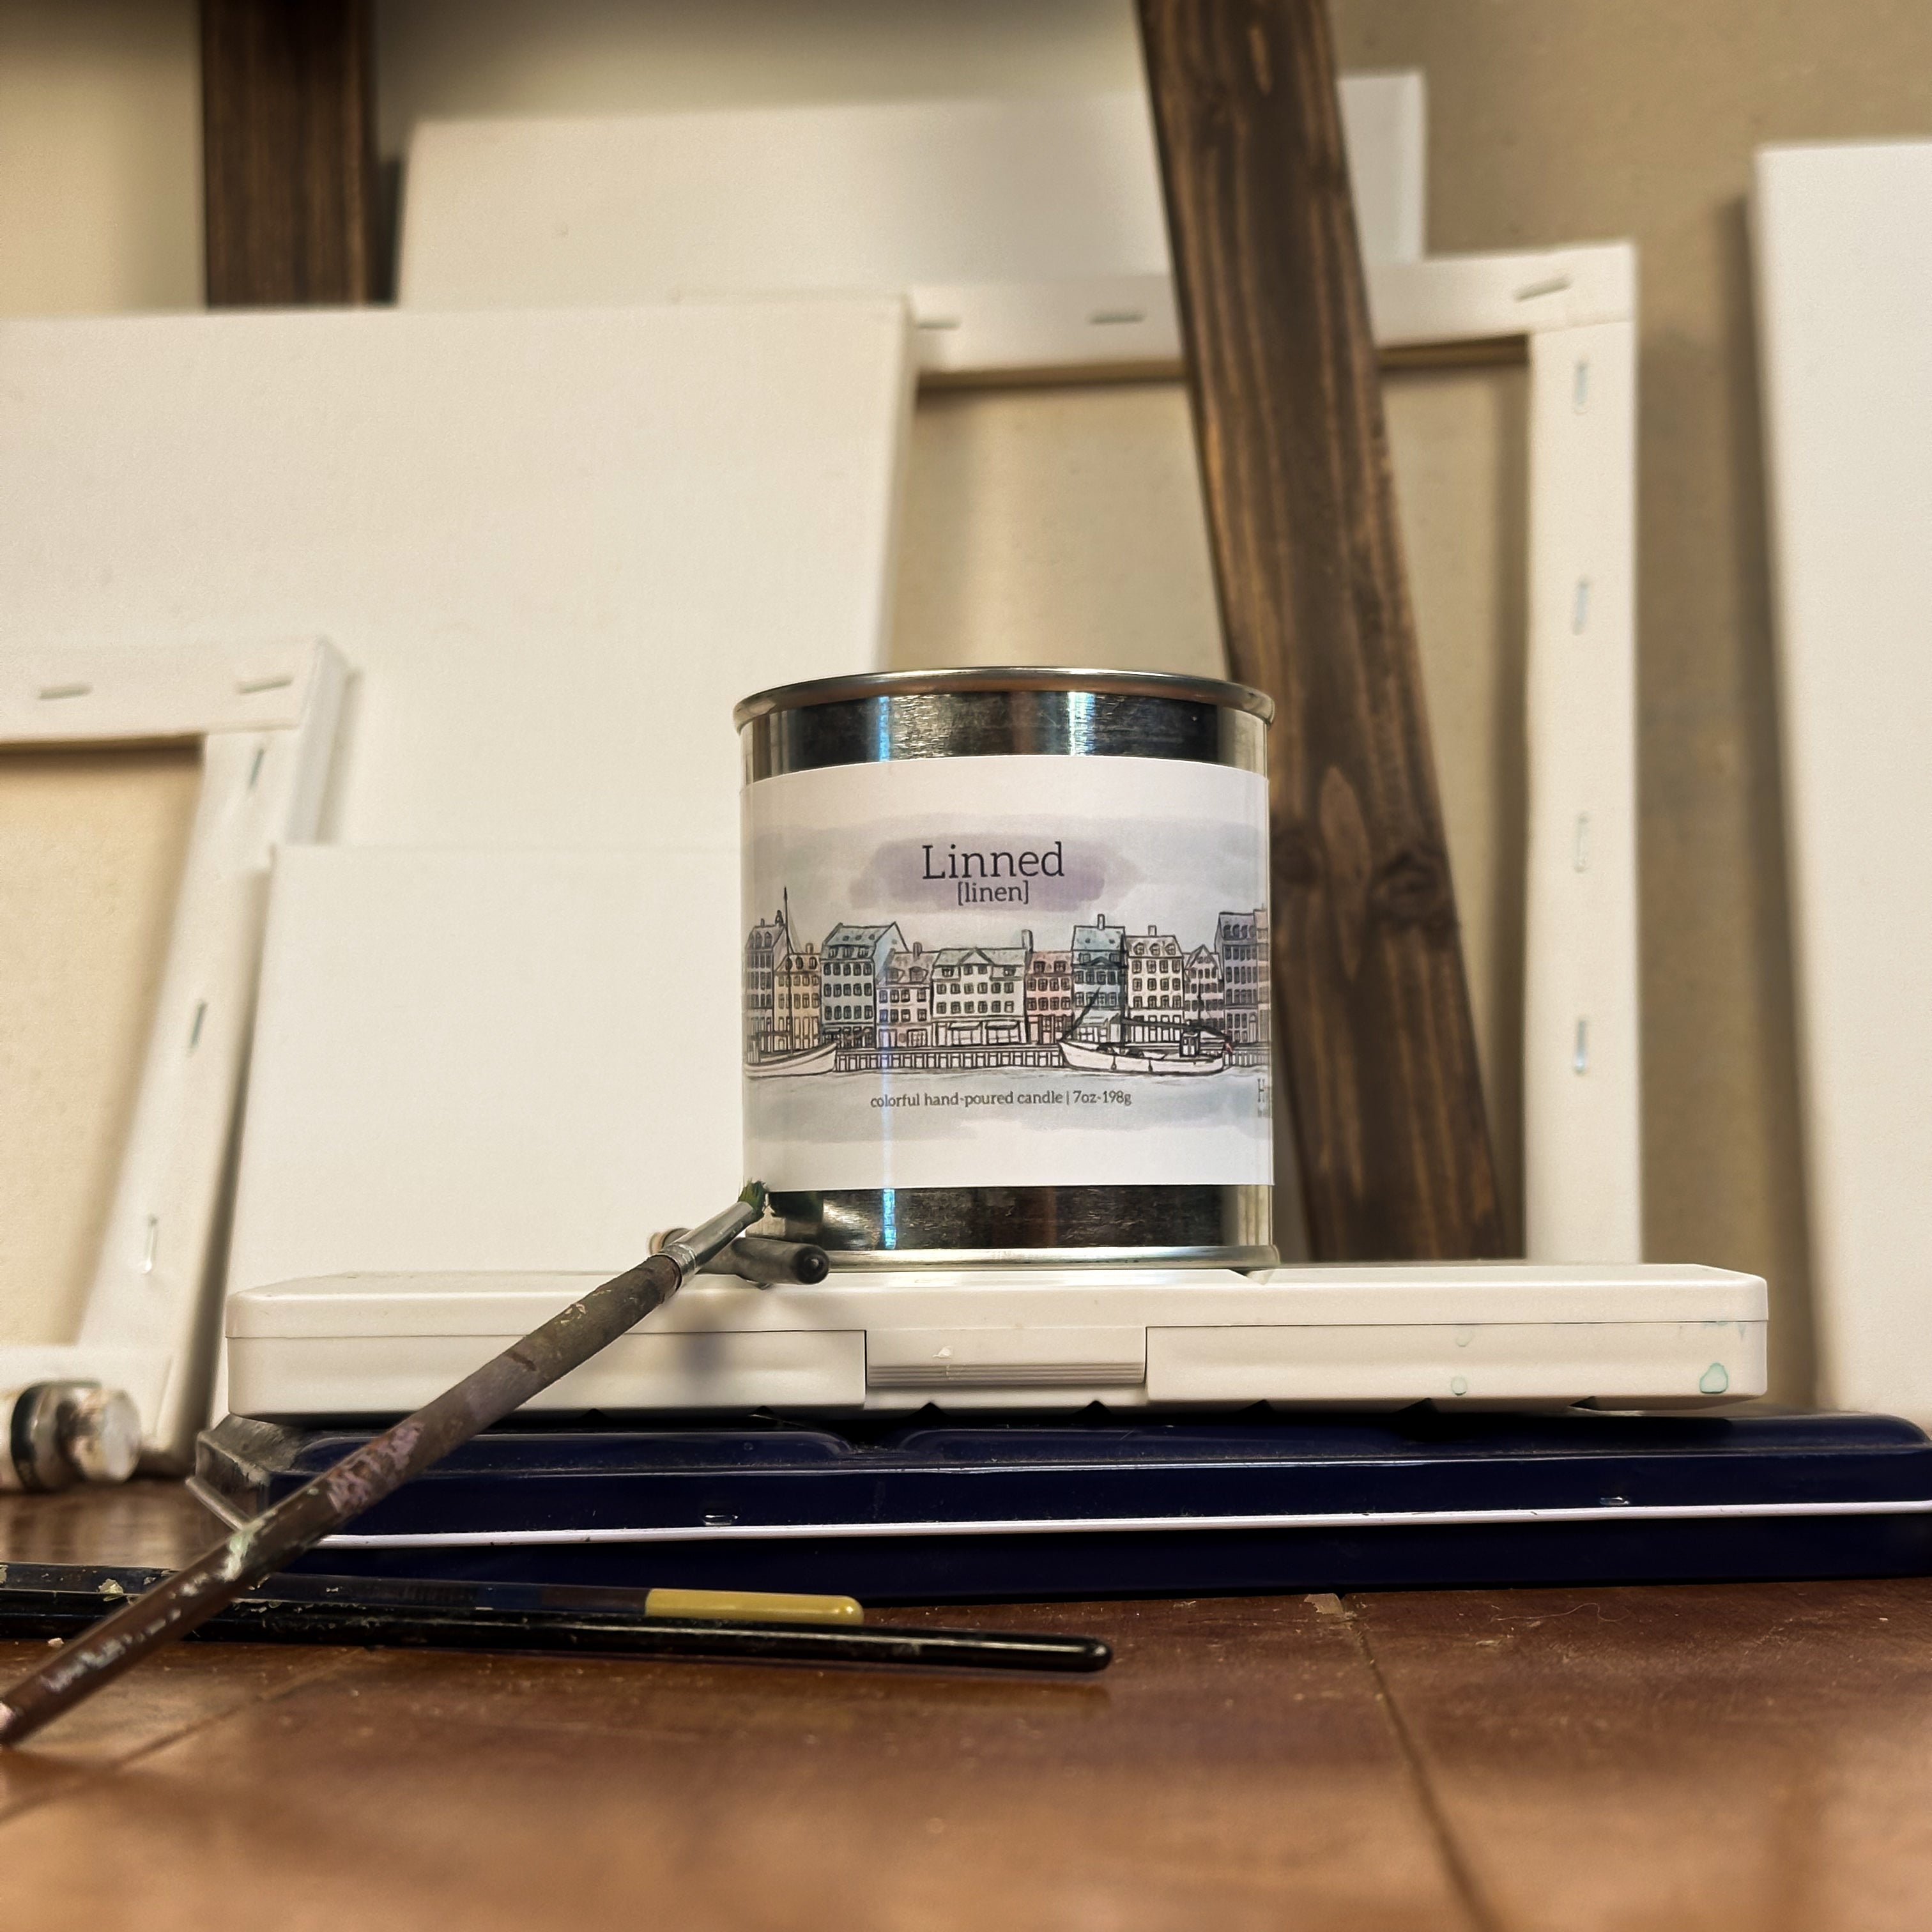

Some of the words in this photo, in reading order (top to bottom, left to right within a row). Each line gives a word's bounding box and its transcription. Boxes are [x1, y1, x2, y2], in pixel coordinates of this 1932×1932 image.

[922, 841, 1064, 880] Linned
[958, 880, 1029, 905] [linen]
[870, 1092, 920, 1108] colorful
[924, 1091, 1013, 1107] hand-poured
[1017, 1090, 1063, 1104] candle
